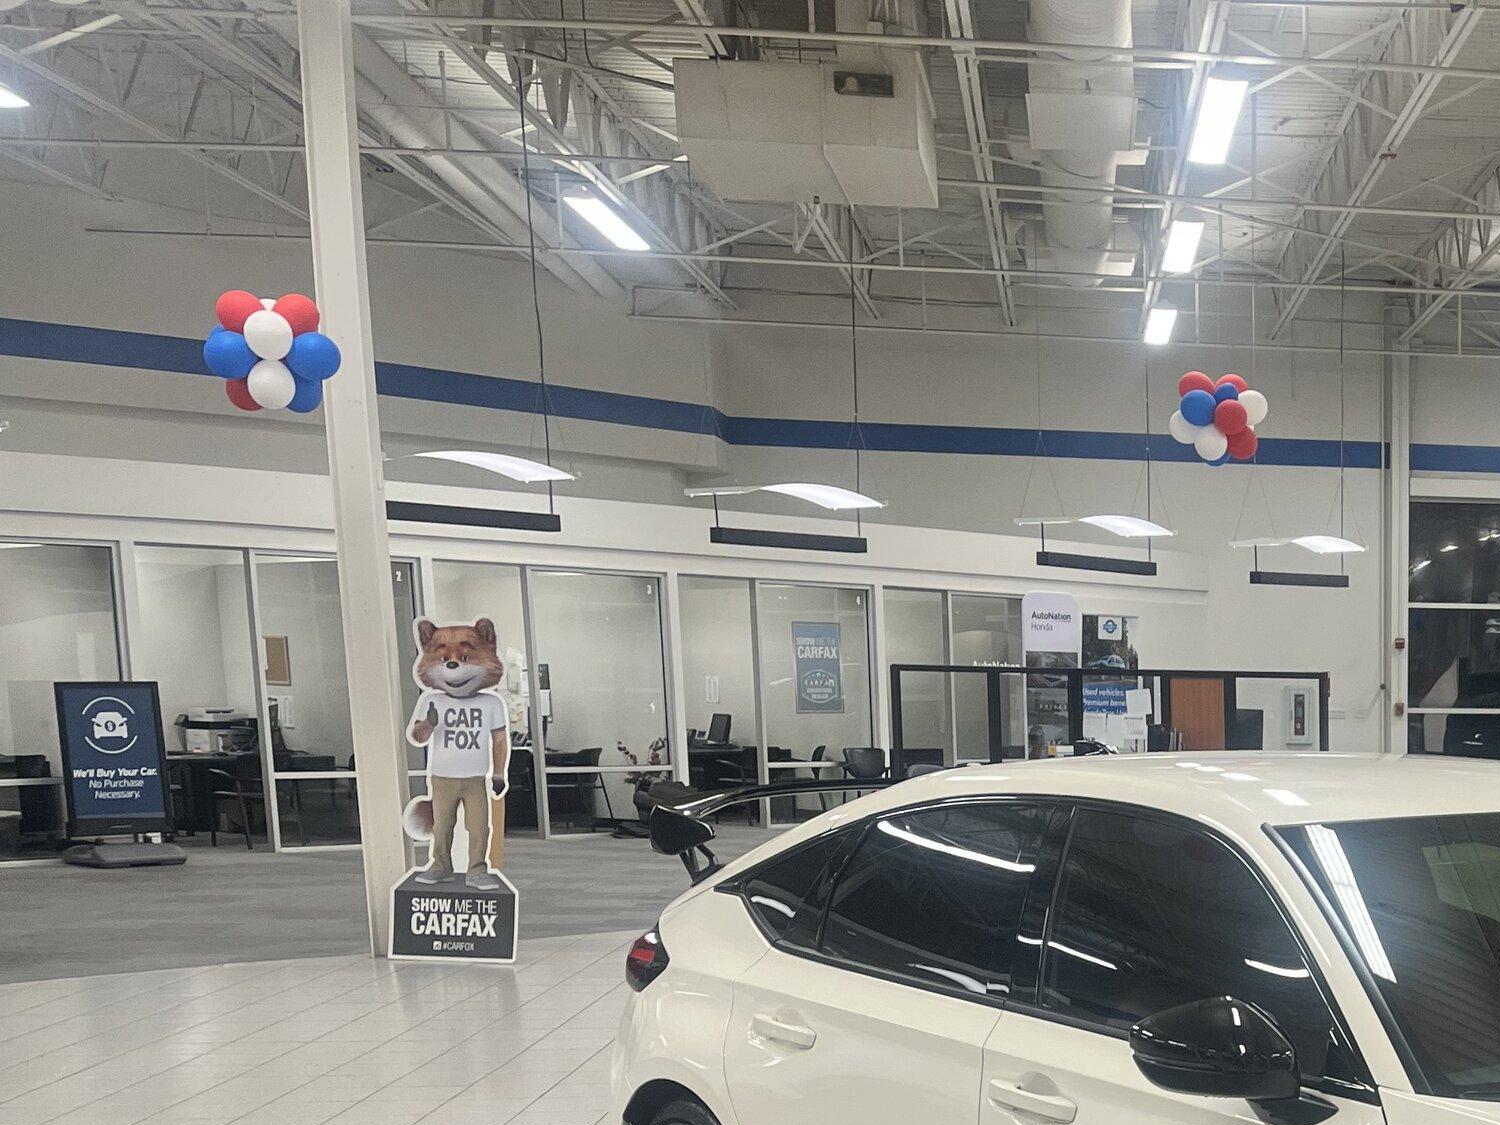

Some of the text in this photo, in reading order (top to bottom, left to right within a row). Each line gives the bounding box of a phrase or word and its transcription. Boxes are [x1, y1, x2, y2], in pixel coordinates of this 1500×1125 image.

[395, 570, 402, 582] 2
[1031, 611, 1072, 621] AutoNation
[1031, 622, 1053, 631] Honda
[797, 646, 838, 659] CARFAX
[1110, 698, 1126, 707] bene
[444, 707, 483, 728] CAR
[444, 730, 481, 750] FOX
[73, 766, 158, 779] We'll Buy Your Car.
[89, 778, 144, 789] No Purchase
[94, 790, 141, 800] Necessary.
[411, 897, 498, 915] SHOW ME THE
[410, 911, 499, 938] CARFAX
[442, 941, 475, 952] #CARFOX
